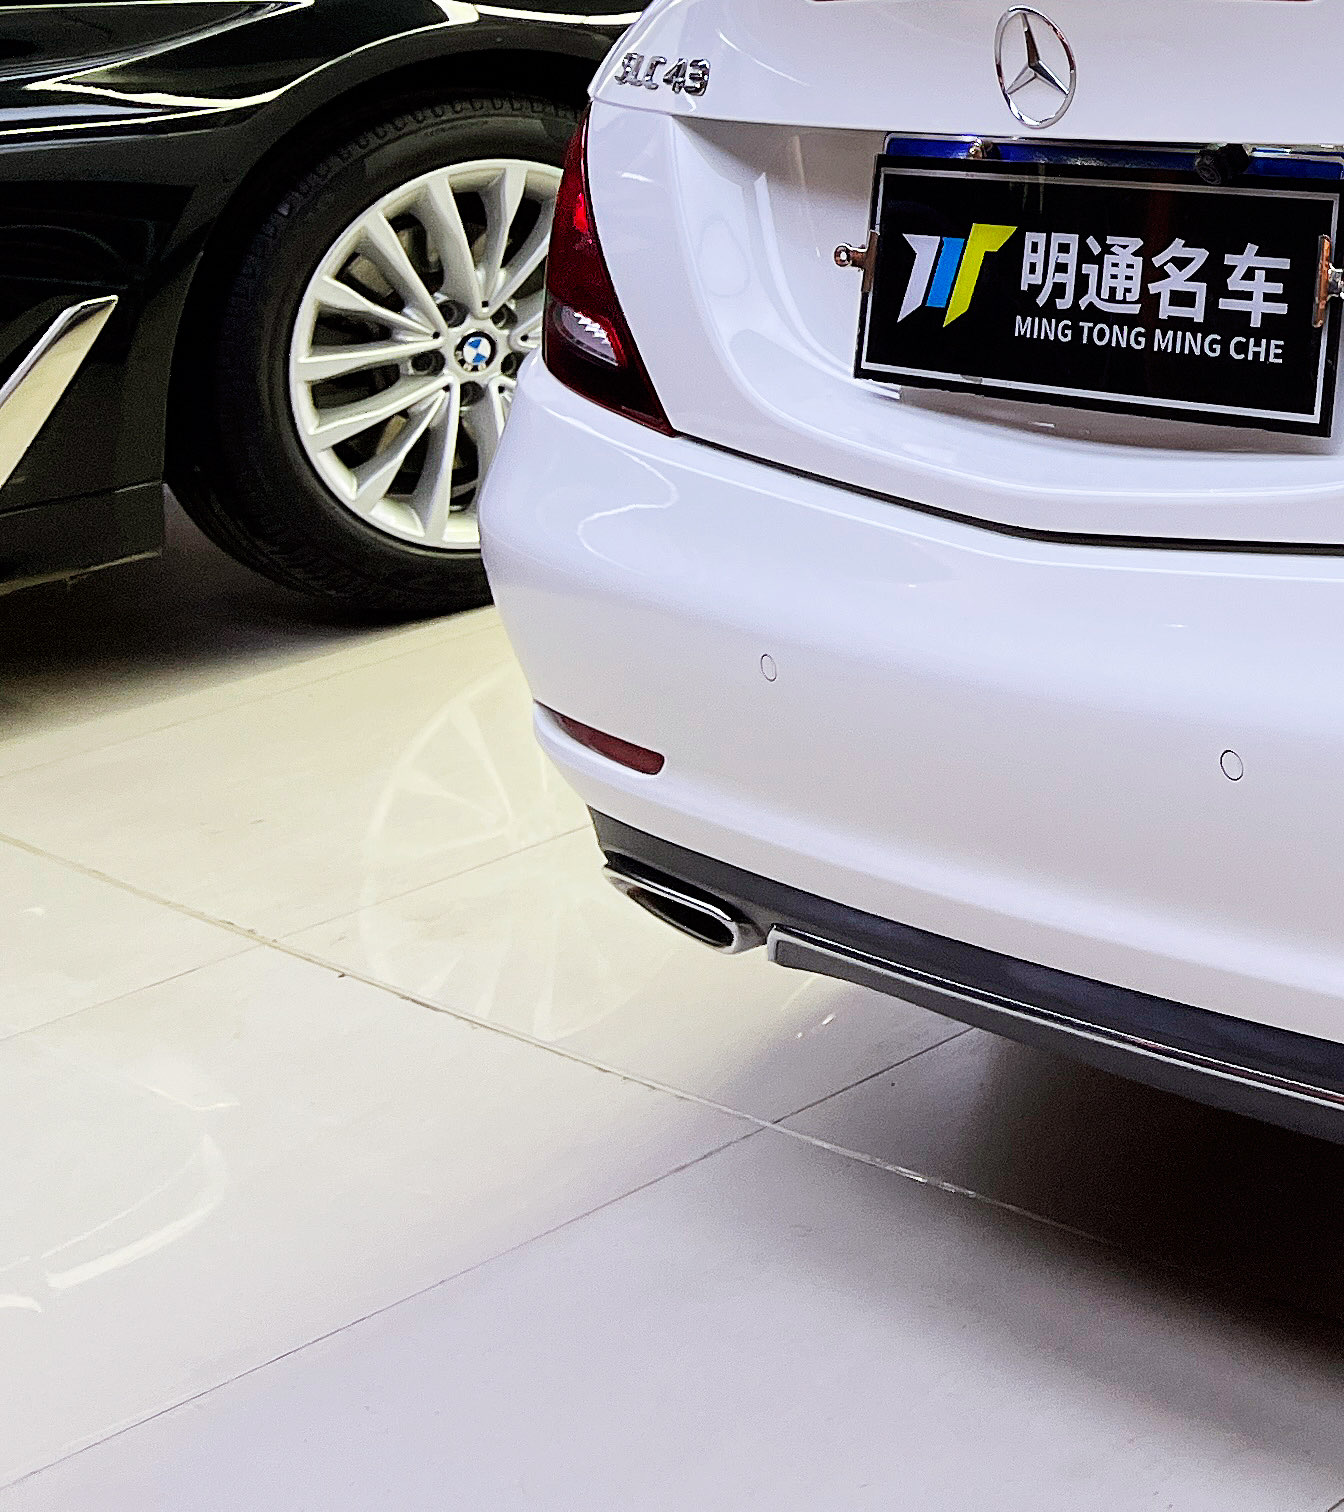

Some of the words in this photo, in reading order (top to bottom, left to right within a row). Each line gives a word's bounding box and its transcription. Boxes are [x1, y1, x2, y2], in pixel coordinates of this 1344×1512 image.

[1019, 231, 1291, 328] 明通名车
[1014, 315, 1073, 343] MING
[1079, 321, 1147, 351] TONG
[1153, 328, 1222, 359] MING
[1229, 335, 1286, 365] CHE
